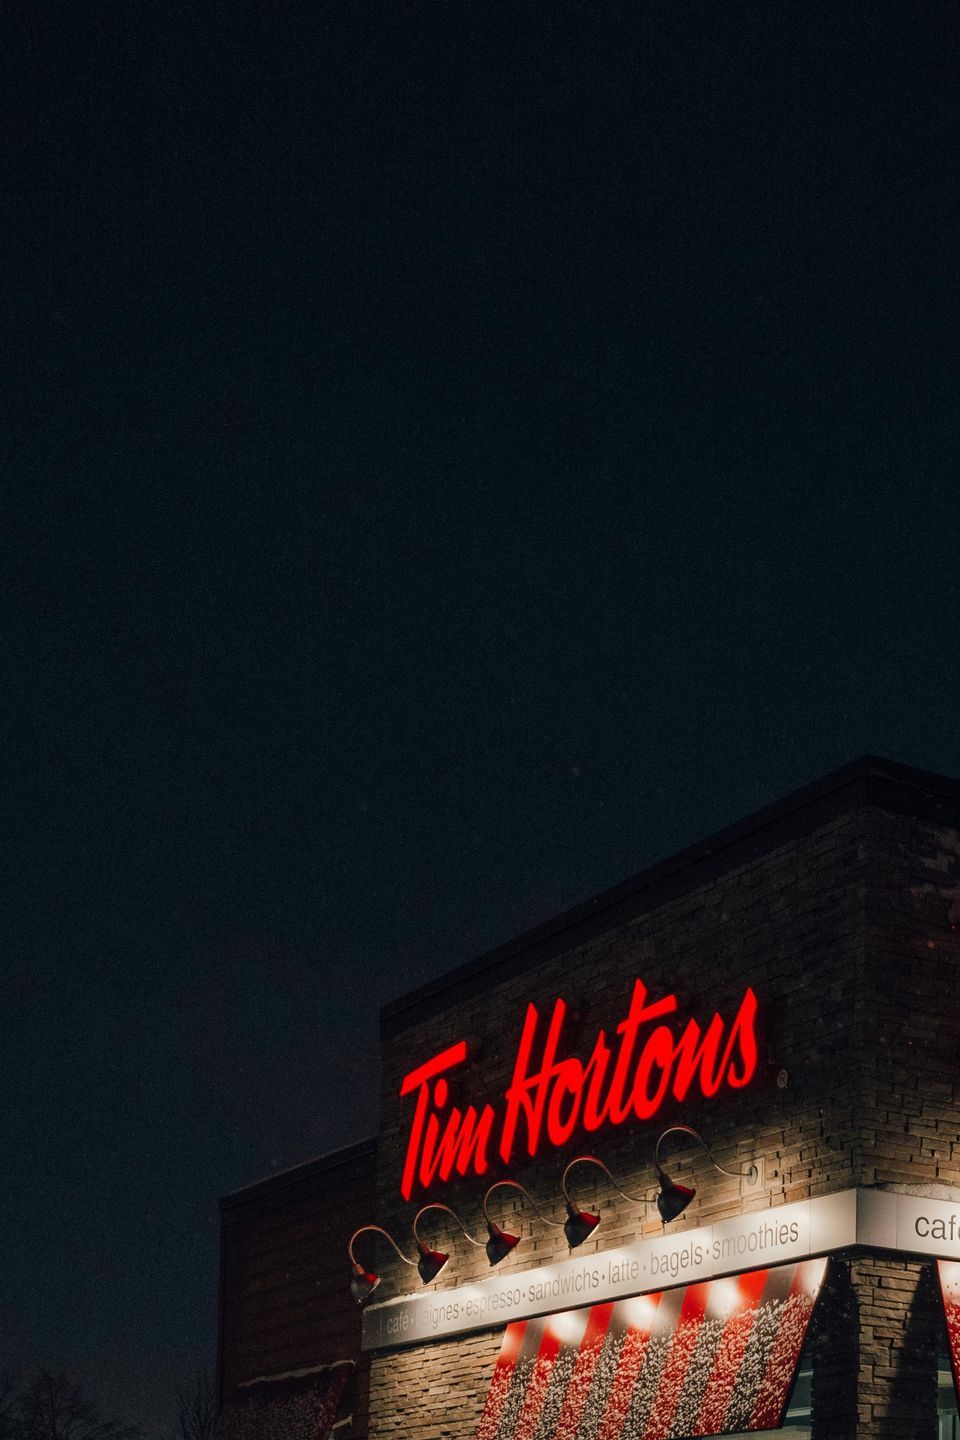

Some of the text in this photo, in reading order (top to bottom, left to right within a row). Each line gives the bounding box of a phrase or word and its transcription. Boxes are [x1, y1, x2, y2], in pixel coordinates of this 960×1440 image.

[400, 977, 758, 1200] Tim Hortons
[386, 1309, 409, 1334] café
[466, 1289, 521, 1319] espresso
[528, 1268, 600, 1301] sandwichs
[608, 1257, 640, 1284] latte
[650, 1241, 703, 1278] bagels
[712, 1219, 799, 1261] smoothies
